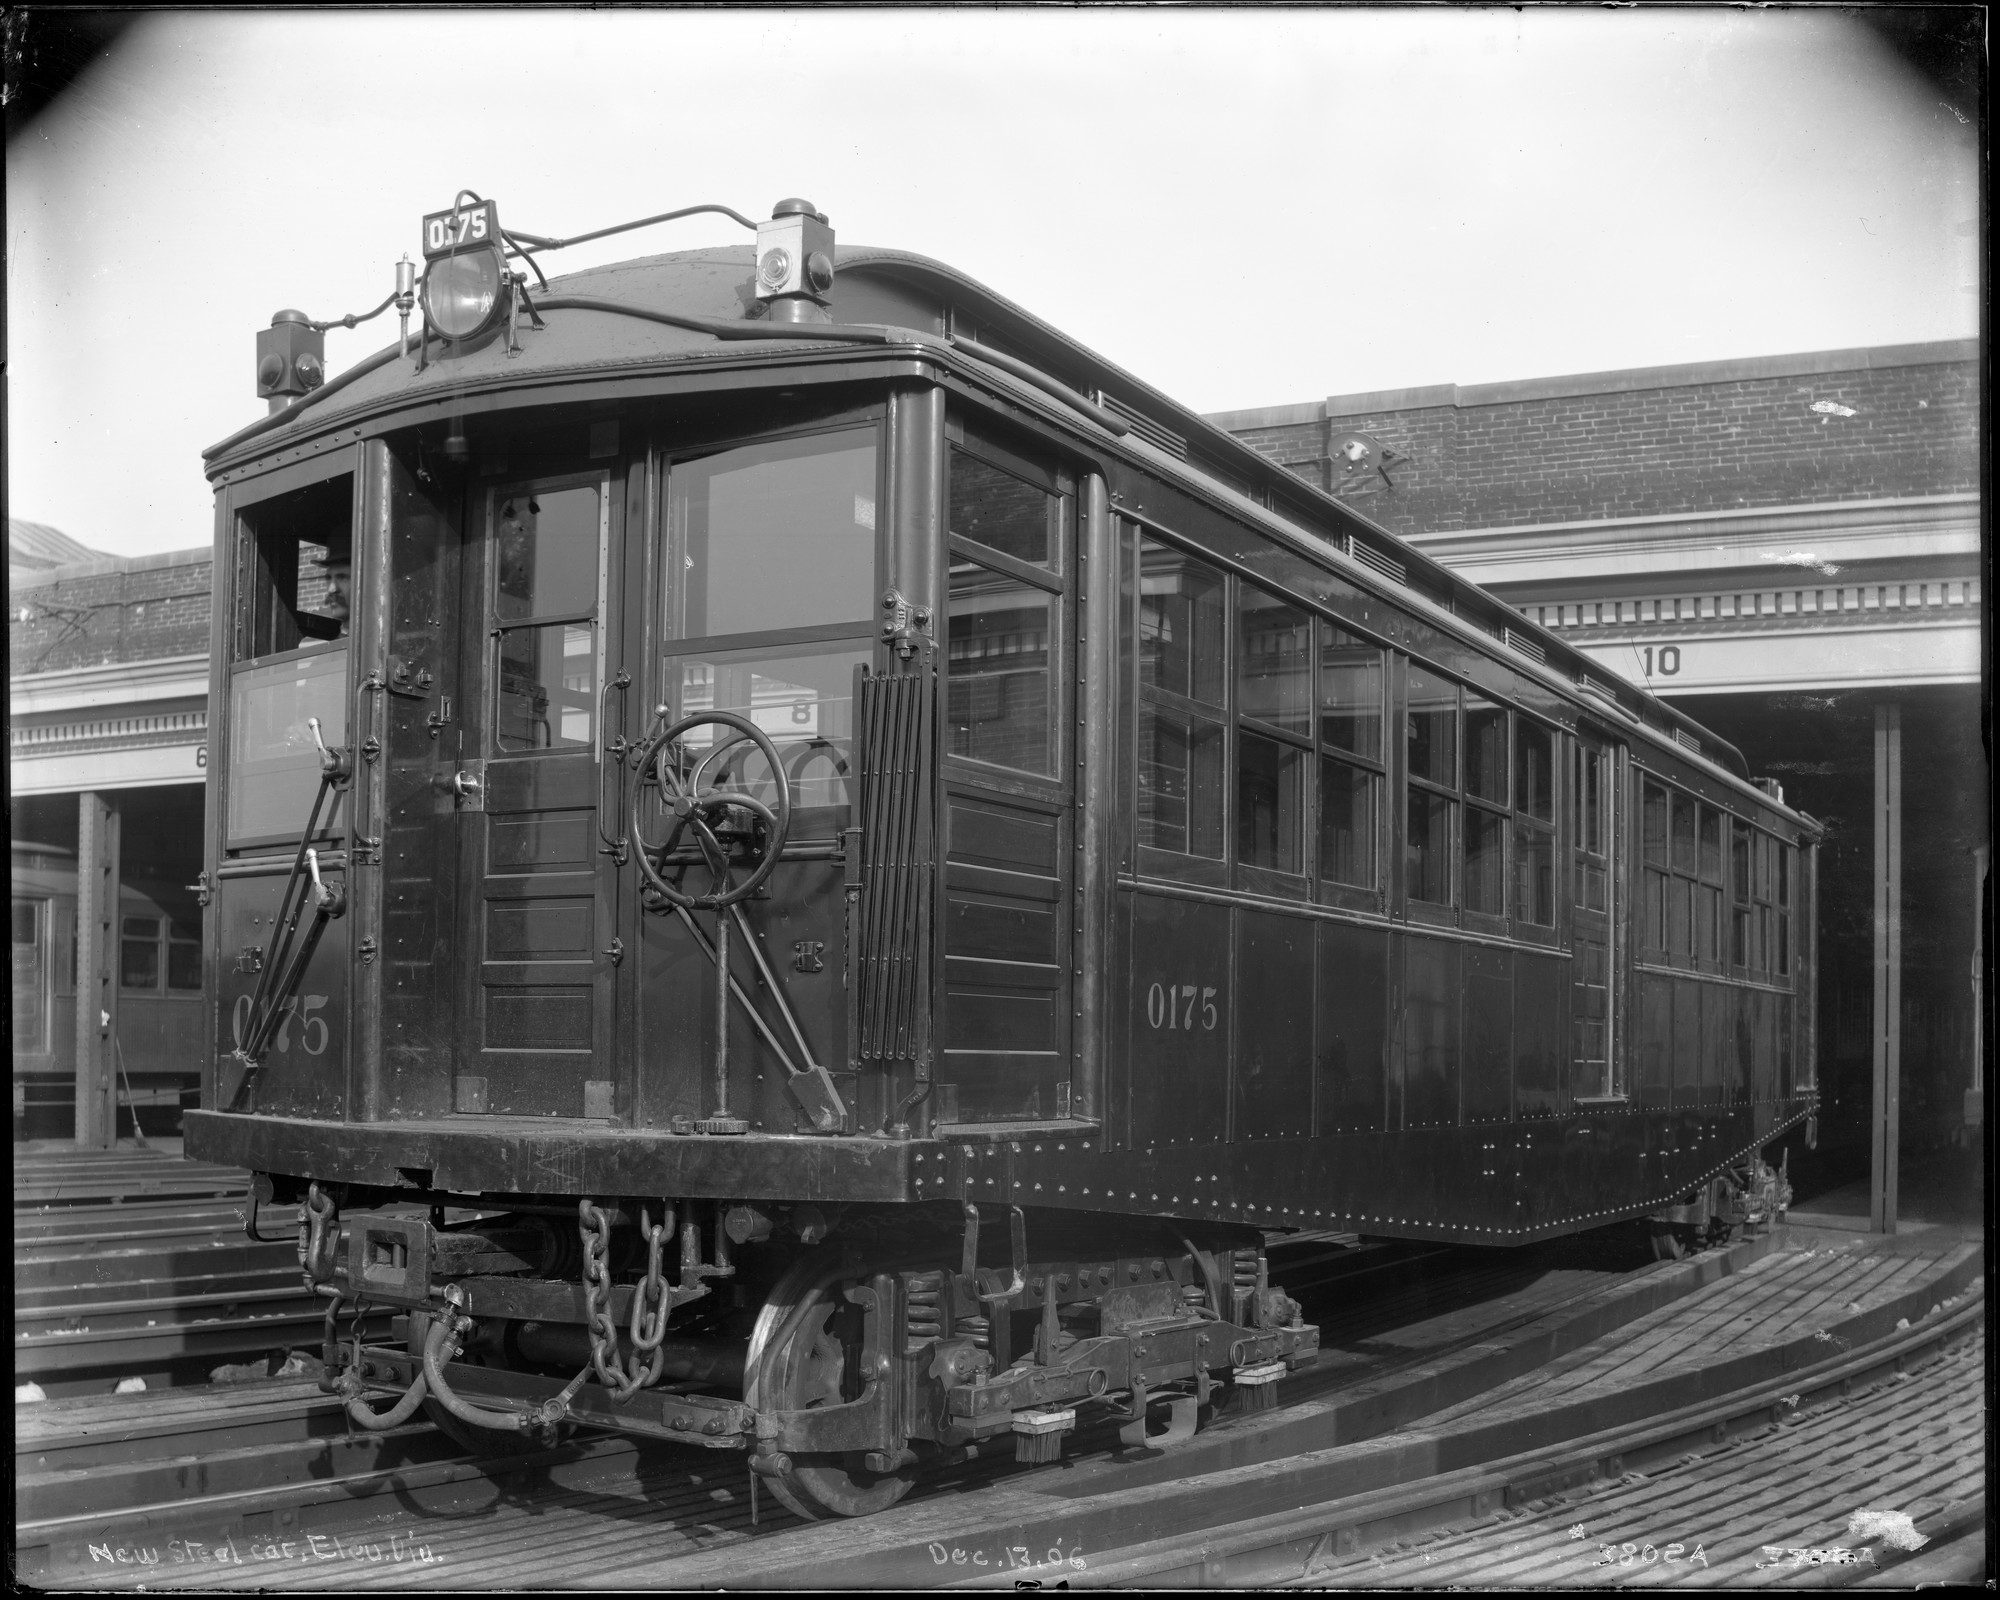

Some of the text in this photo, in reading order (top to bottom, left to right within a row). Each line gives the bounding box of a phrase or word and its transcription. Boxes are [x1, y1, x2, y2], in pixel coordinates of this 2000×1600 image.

[1643, 646, 1681, 676] 10
[791, 699, 811, 724] 8
[196, 747, 207, 768] 6
[1147, 983, 1218, 1030] 0175
